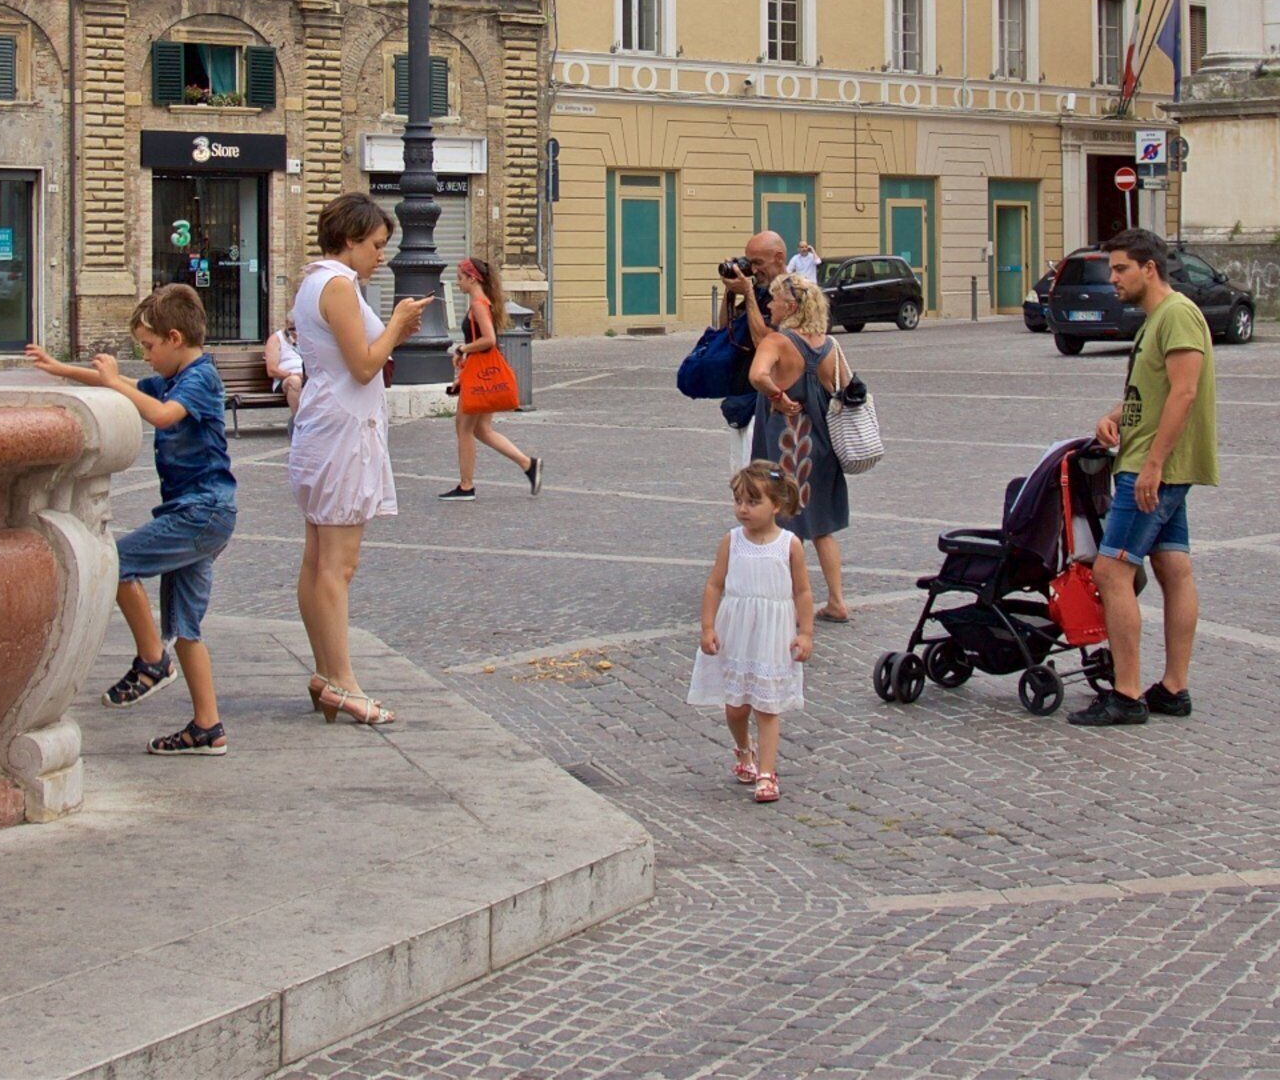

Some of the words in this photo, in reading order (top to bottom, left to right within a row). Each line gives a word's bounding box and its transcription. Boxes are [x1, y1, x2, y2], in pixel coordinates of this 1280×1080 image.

[192, 136, 210, 163] 3
[211, 142, 240, 158] Store
[171, 220, 191, 247] 3
